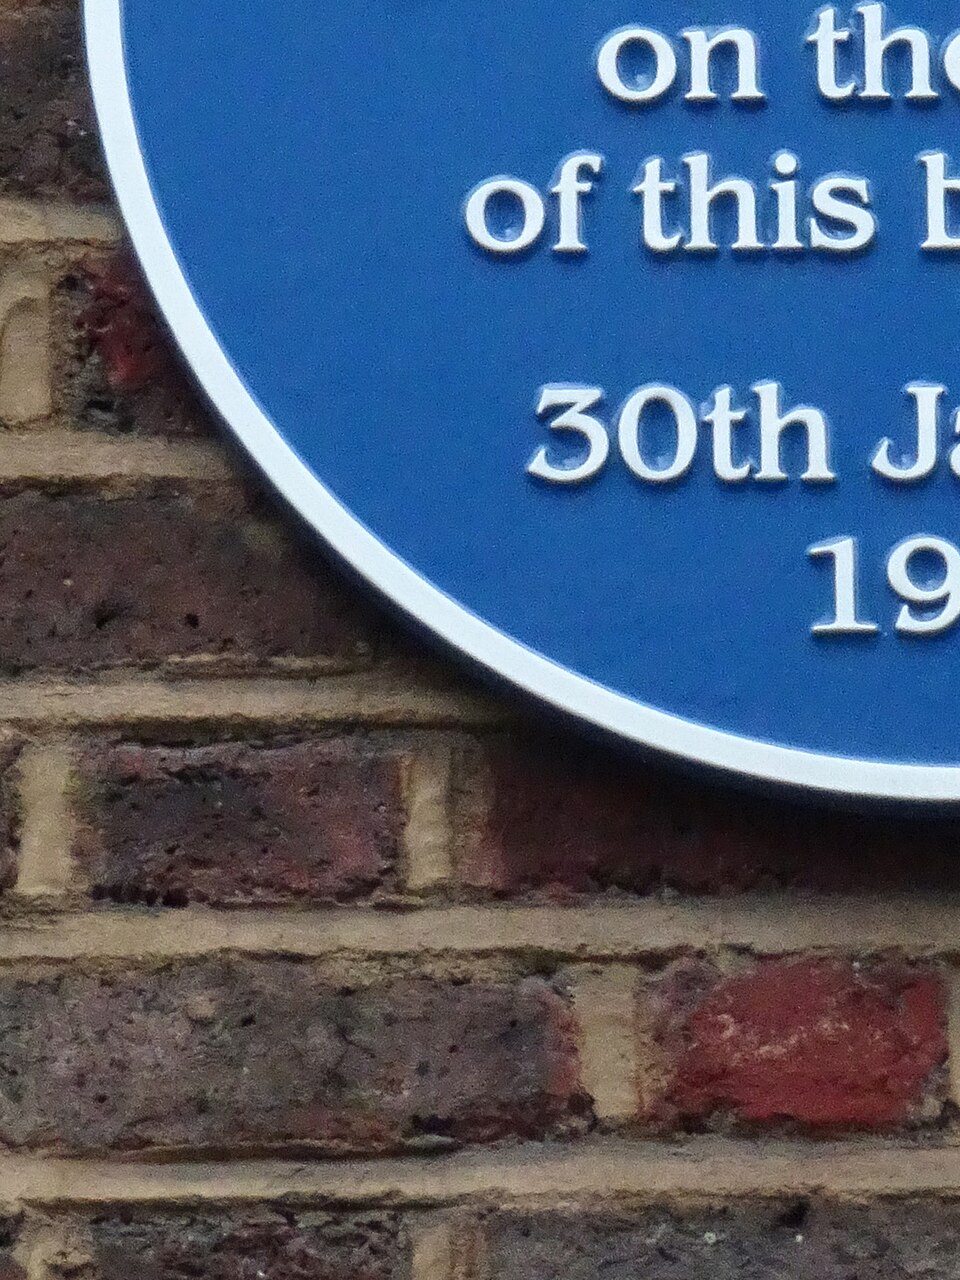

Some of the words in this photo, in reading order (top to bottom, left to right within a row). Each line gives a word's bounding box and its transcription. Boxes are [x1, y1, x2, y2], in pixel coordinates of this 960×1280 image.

[595, 24, 767, 102] on
[463, 149, 603, 254] of
[630, 149, 878, 253] this
[525, 379, 837, 483] 30th
